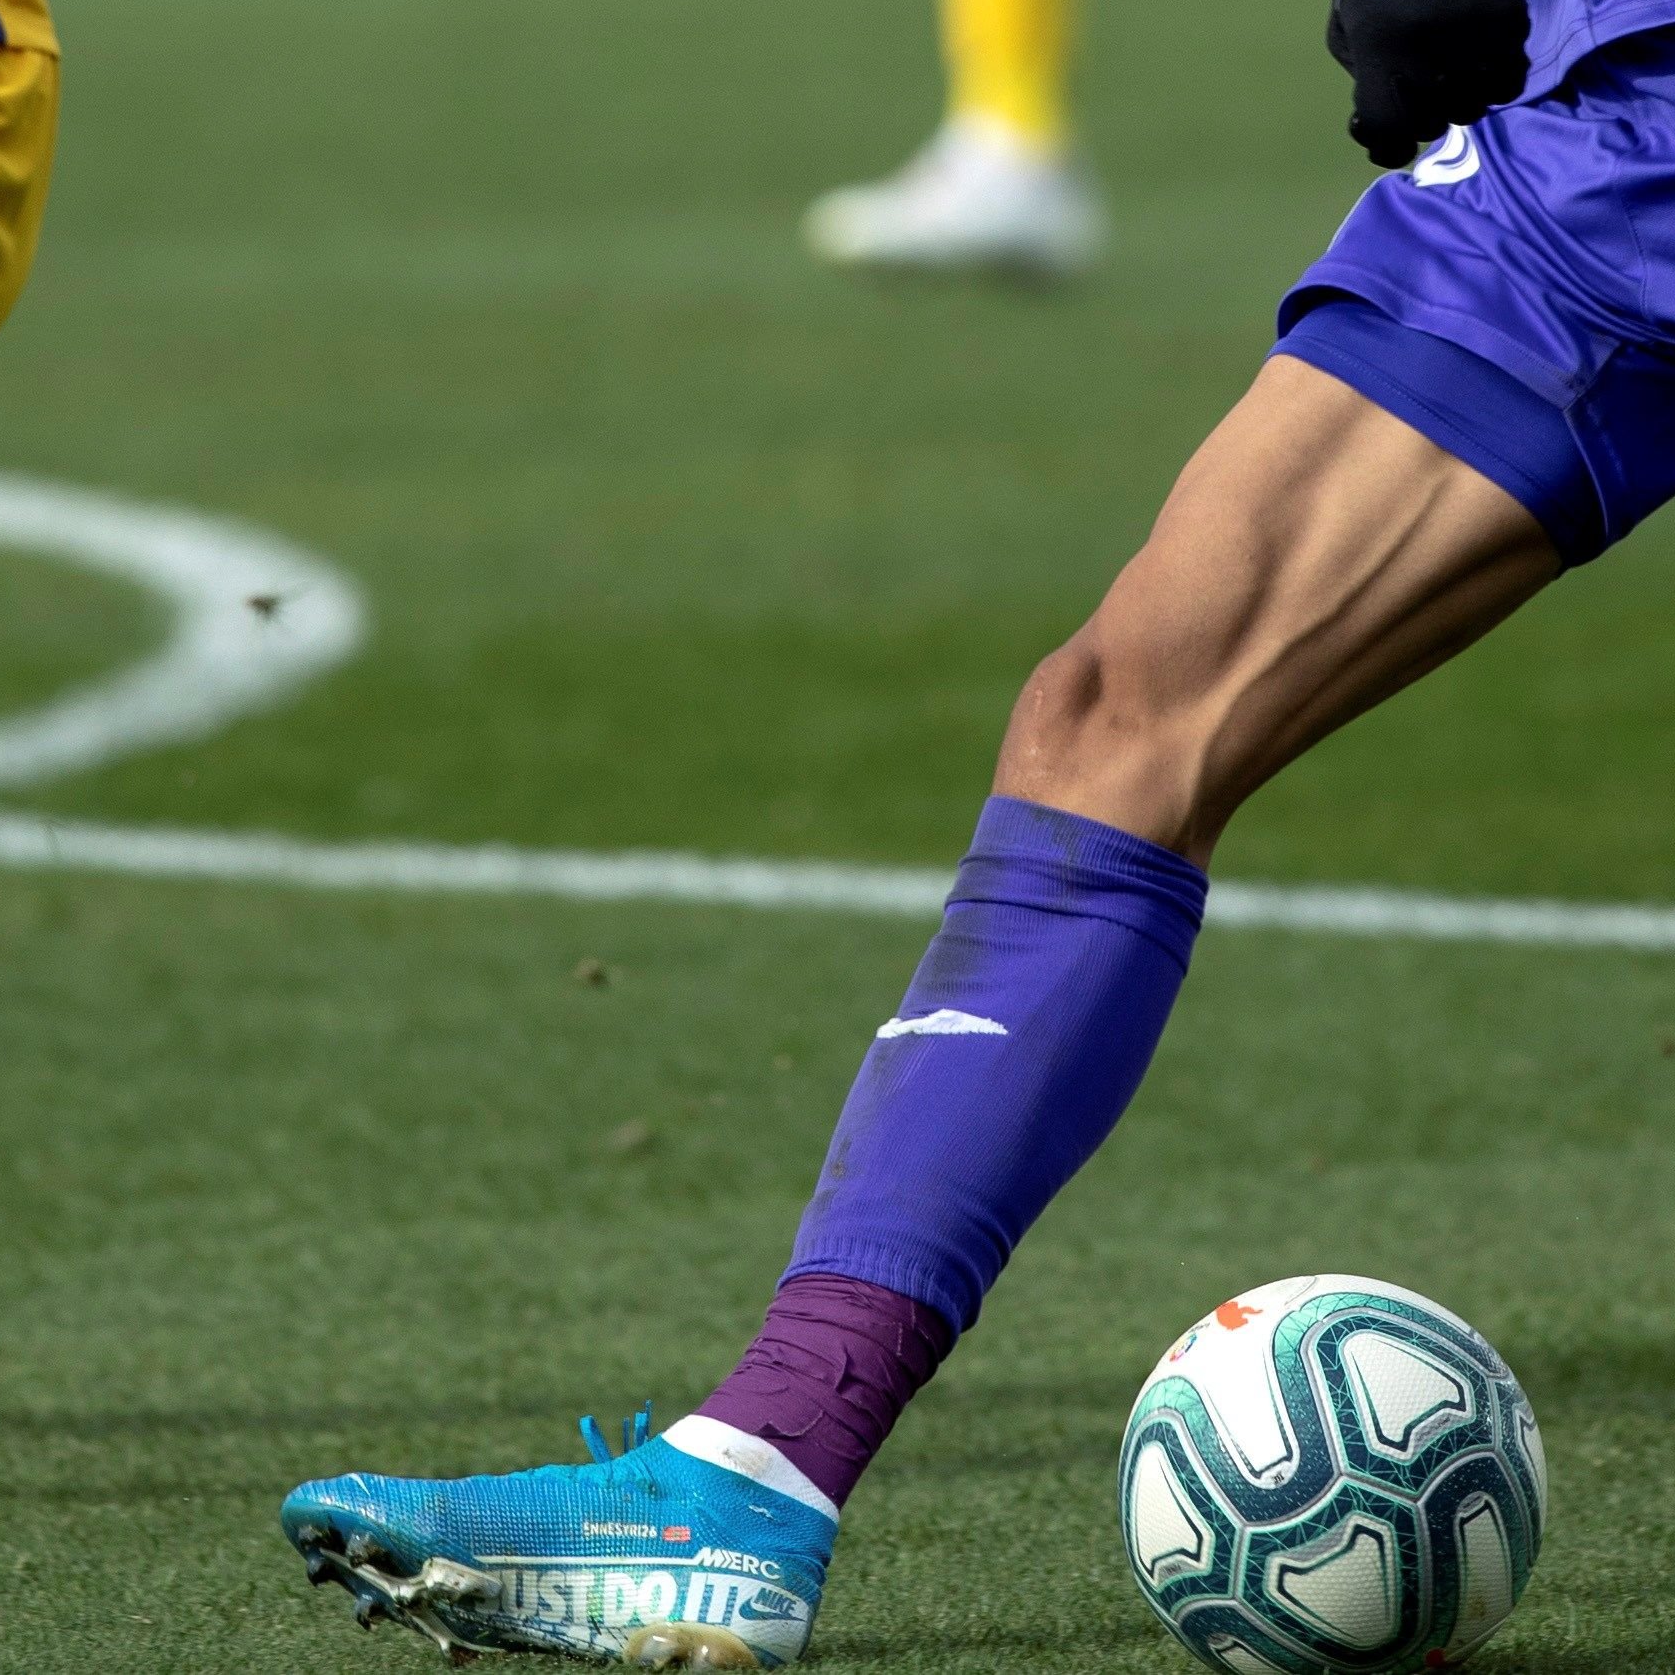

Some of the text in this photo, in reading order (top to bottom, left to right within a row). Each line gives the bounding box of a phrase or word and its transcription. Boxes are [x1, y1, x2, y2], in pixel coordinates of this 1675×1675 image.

[691, 1547, 781, 1580] MERC
[604, 1570, 678, 1627] DO
[680, 1572, 740, 1624] IT
[754, 1587, 798, 1614] NIKE
